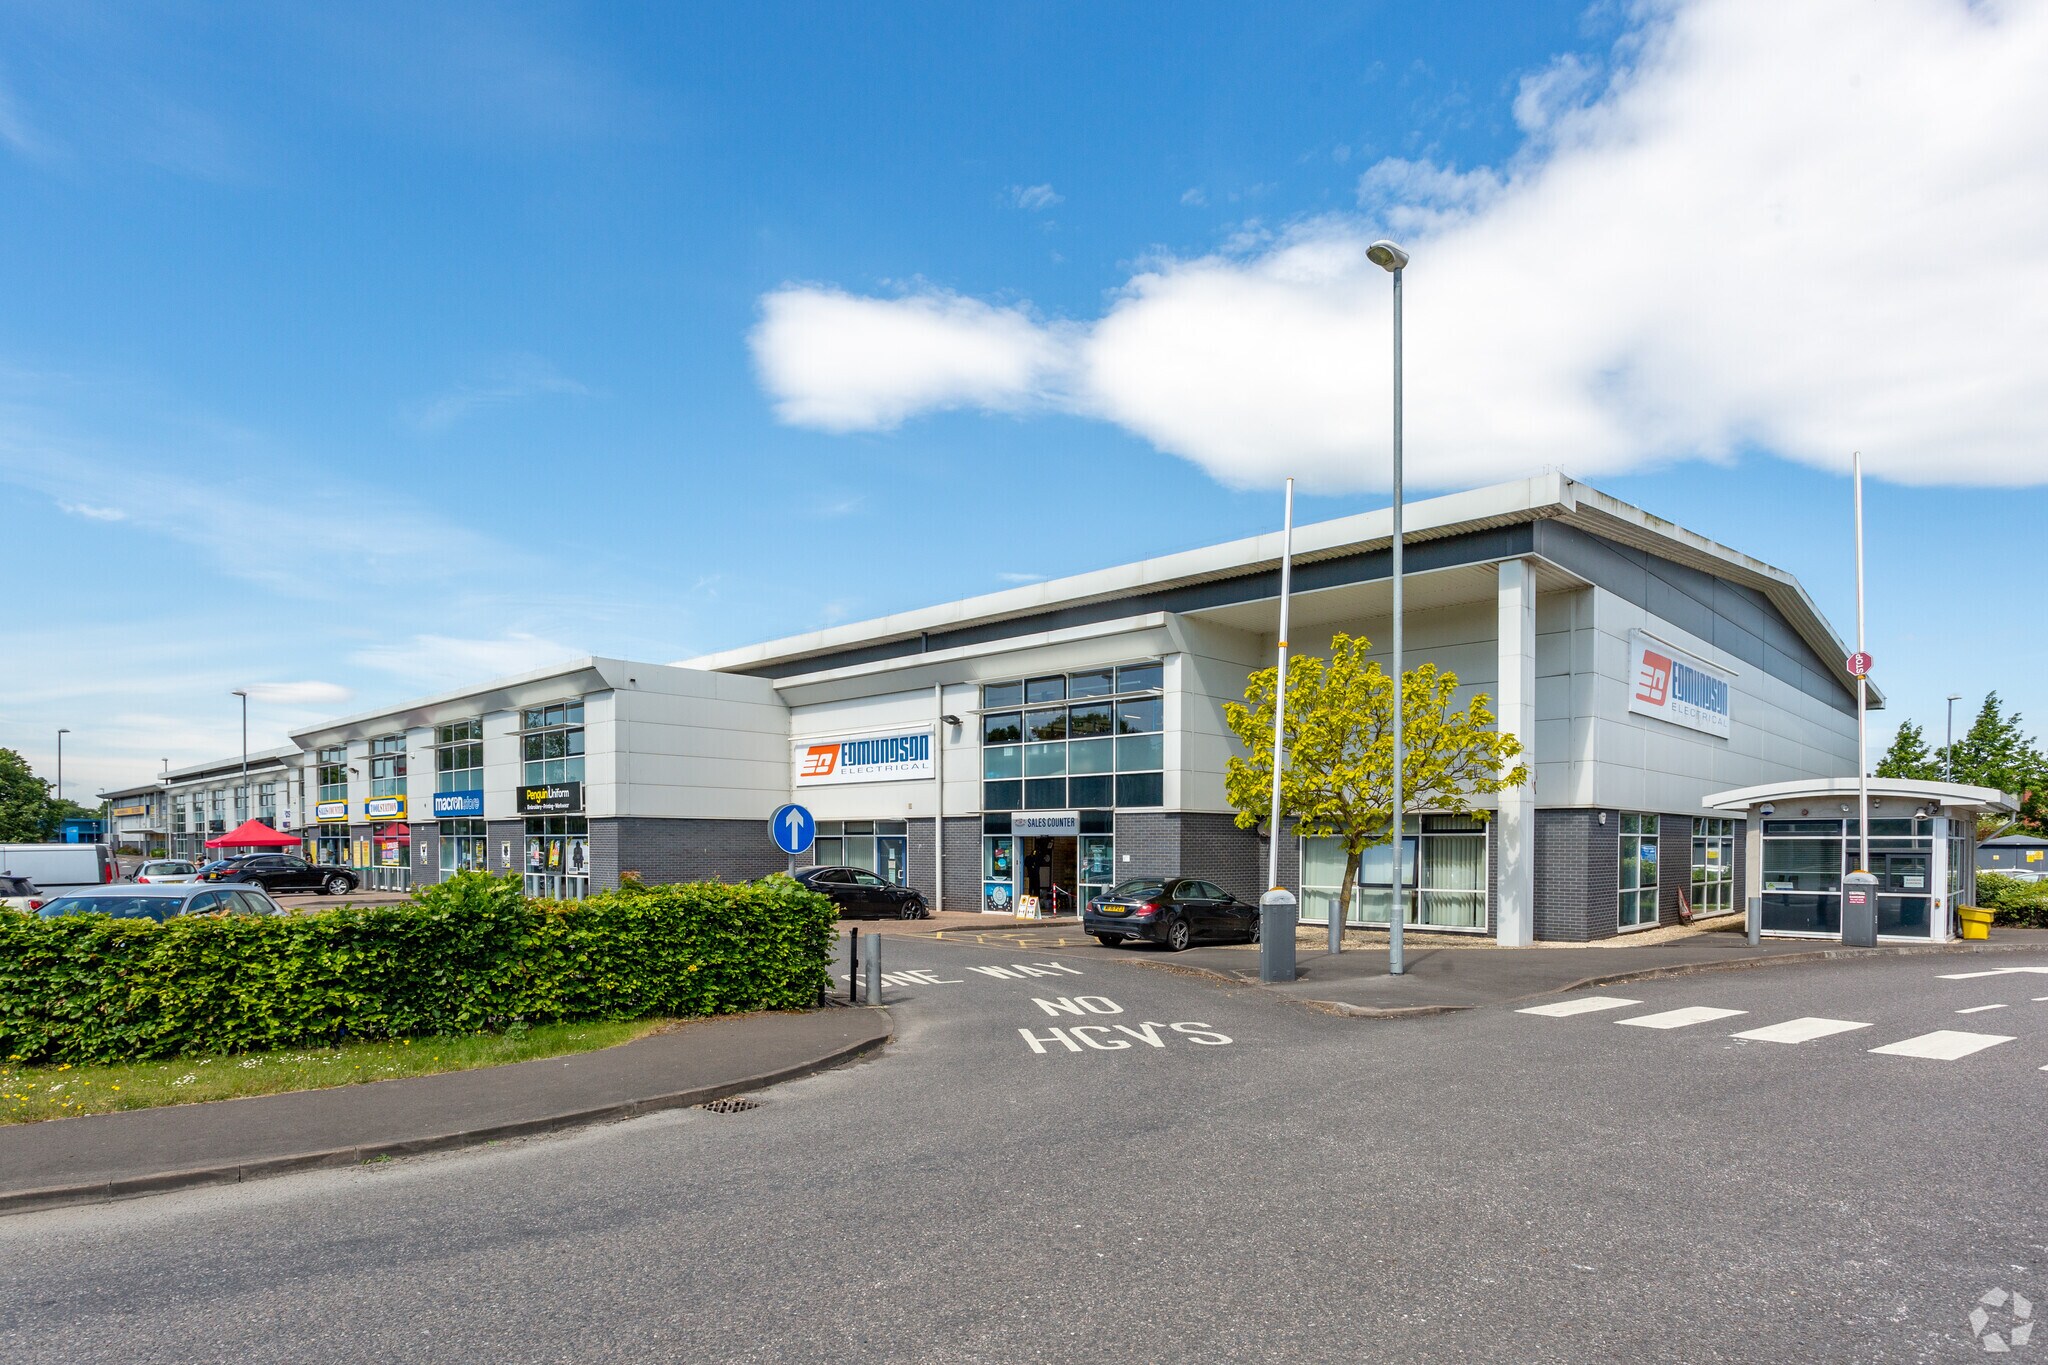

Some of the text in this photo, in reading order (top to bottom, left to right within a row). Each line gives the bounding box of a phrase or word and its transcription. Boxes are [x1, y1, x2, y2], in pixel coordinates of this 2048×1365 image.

[1855, 654, 1864, 674] STOP
[1672, 661, 1728, 716] EDMUNDSON
[1671, 702, 1728, 728] ELECTRICAL
[841, 735, 929, 767] EDMUNDSON
[841, 763, 929, 775] ELECTRICAL
[526, 785, 570, 803] Penguin Uniform
[1027, 817, 1075, 828] SALES COUNTER
[841, 962, 1084, 988] ONE WAY
[1030, 996, 1124, 1016] NO
[1018, 1021, 1234, 1054] HGV'S
